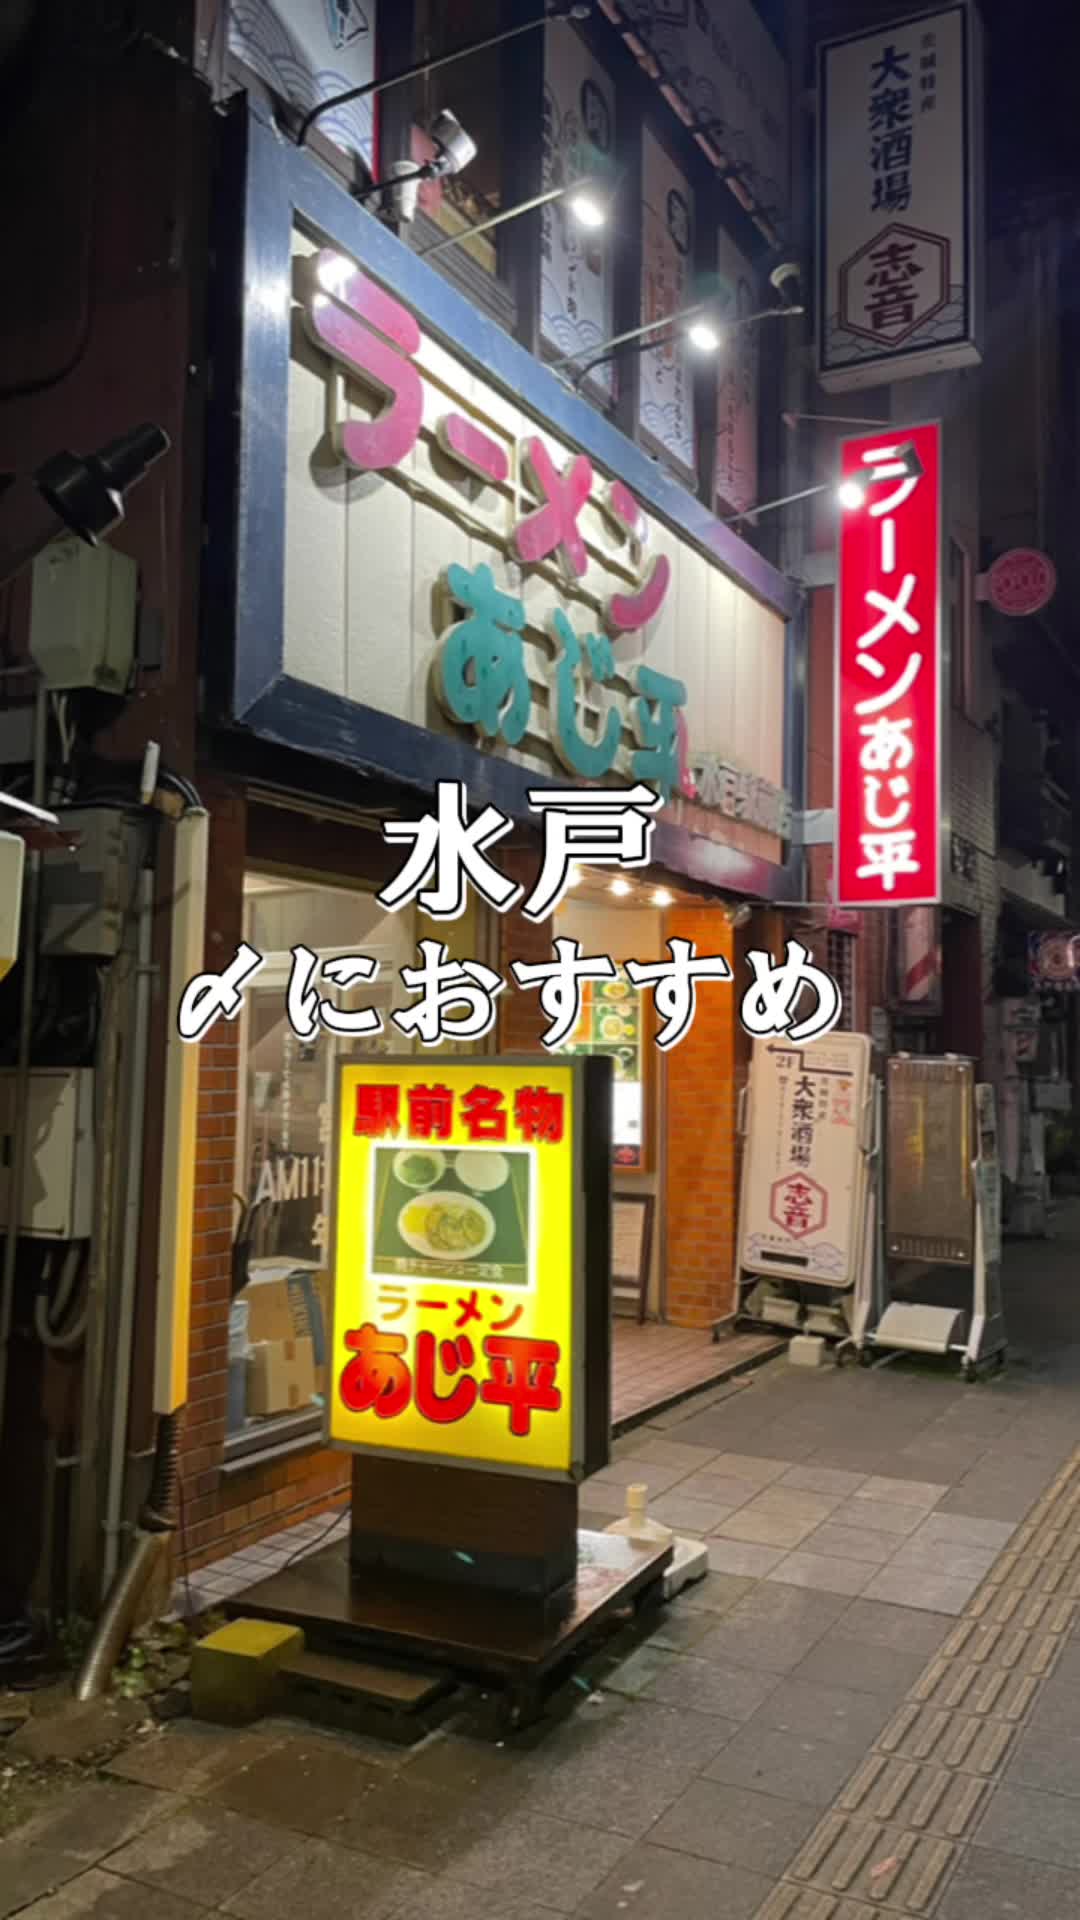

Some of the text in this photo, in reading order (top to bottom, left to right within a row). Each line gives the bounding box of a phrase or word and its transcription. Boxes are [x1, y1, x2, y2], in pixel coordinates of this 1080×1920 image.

[868, 45, 913, 213] 大衆酒場
[864, 242, 924, 331] 志音
[306, 247, 671, 631] ラーメン
[434, 562, 690, 800] あじ平
[352, 1083, 566, 1145] 駅前名物
[788, 1075, 817, 1170] 大衆酒場
[376, 1285, 524, 1332] ラーメン
[339, 1322, 563, 1437] あじ平
